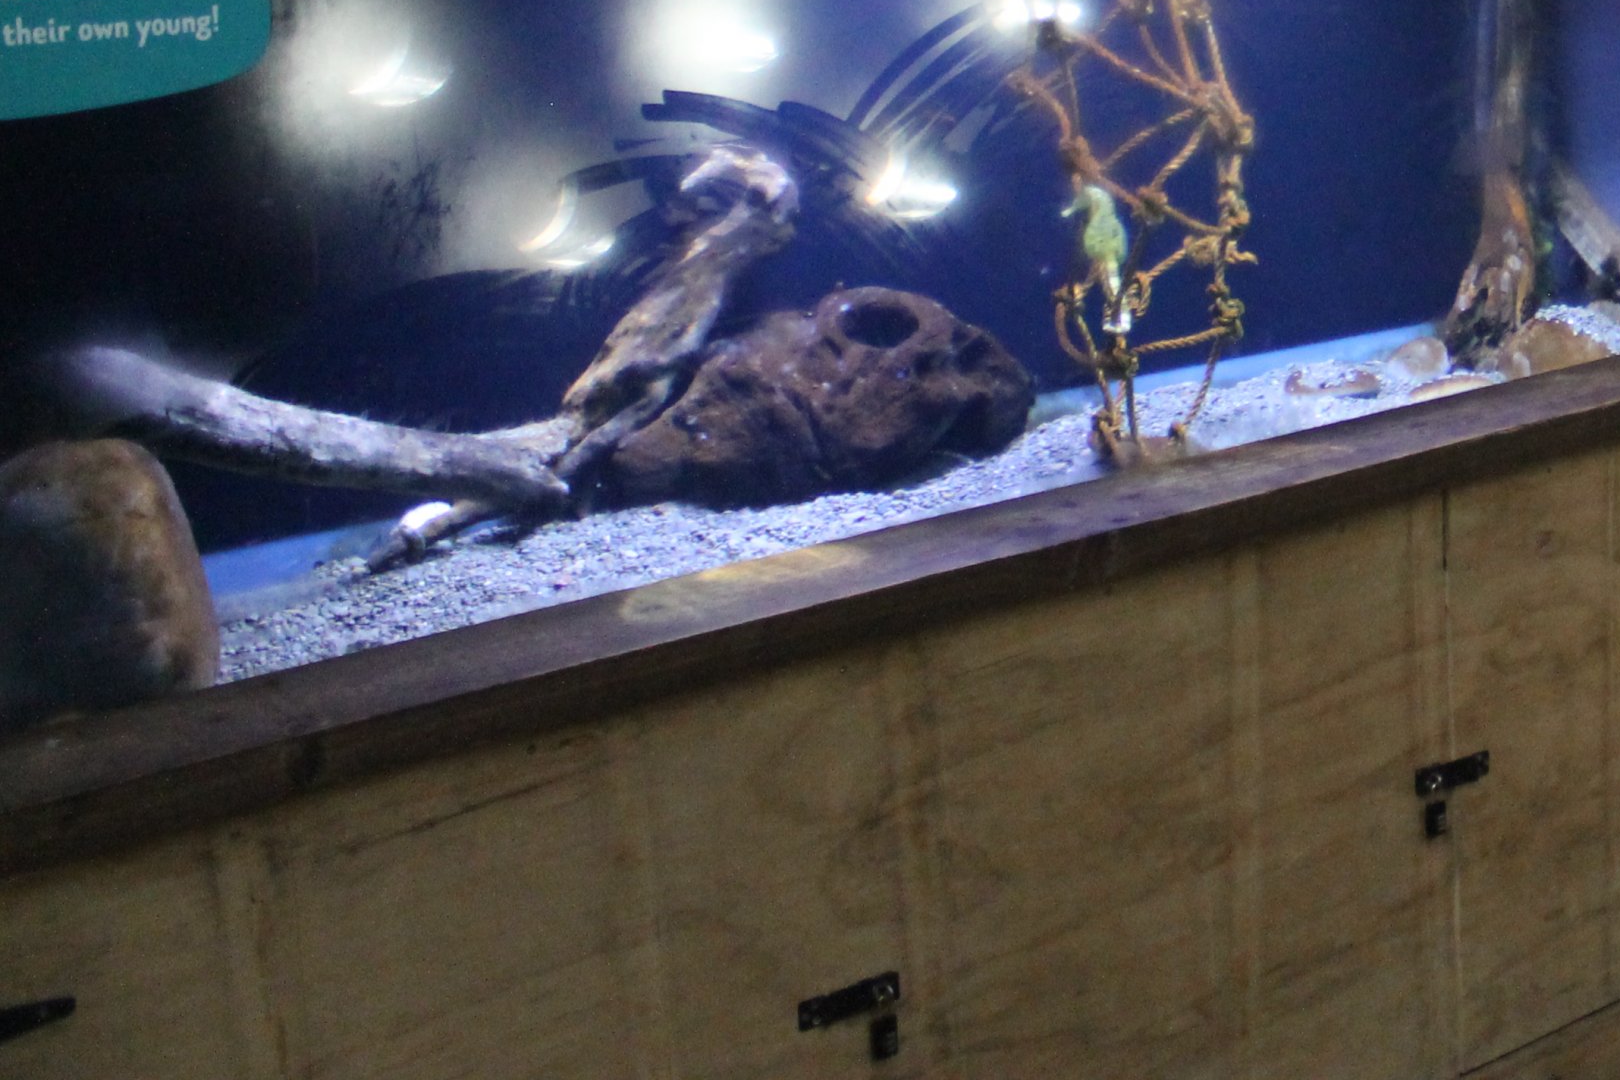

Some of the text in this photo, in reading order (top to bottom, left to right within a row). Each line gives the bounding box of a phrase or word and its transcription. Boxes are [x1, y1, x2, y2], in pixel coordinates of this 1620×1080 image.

[3, 4, 220, 48] their own young!
